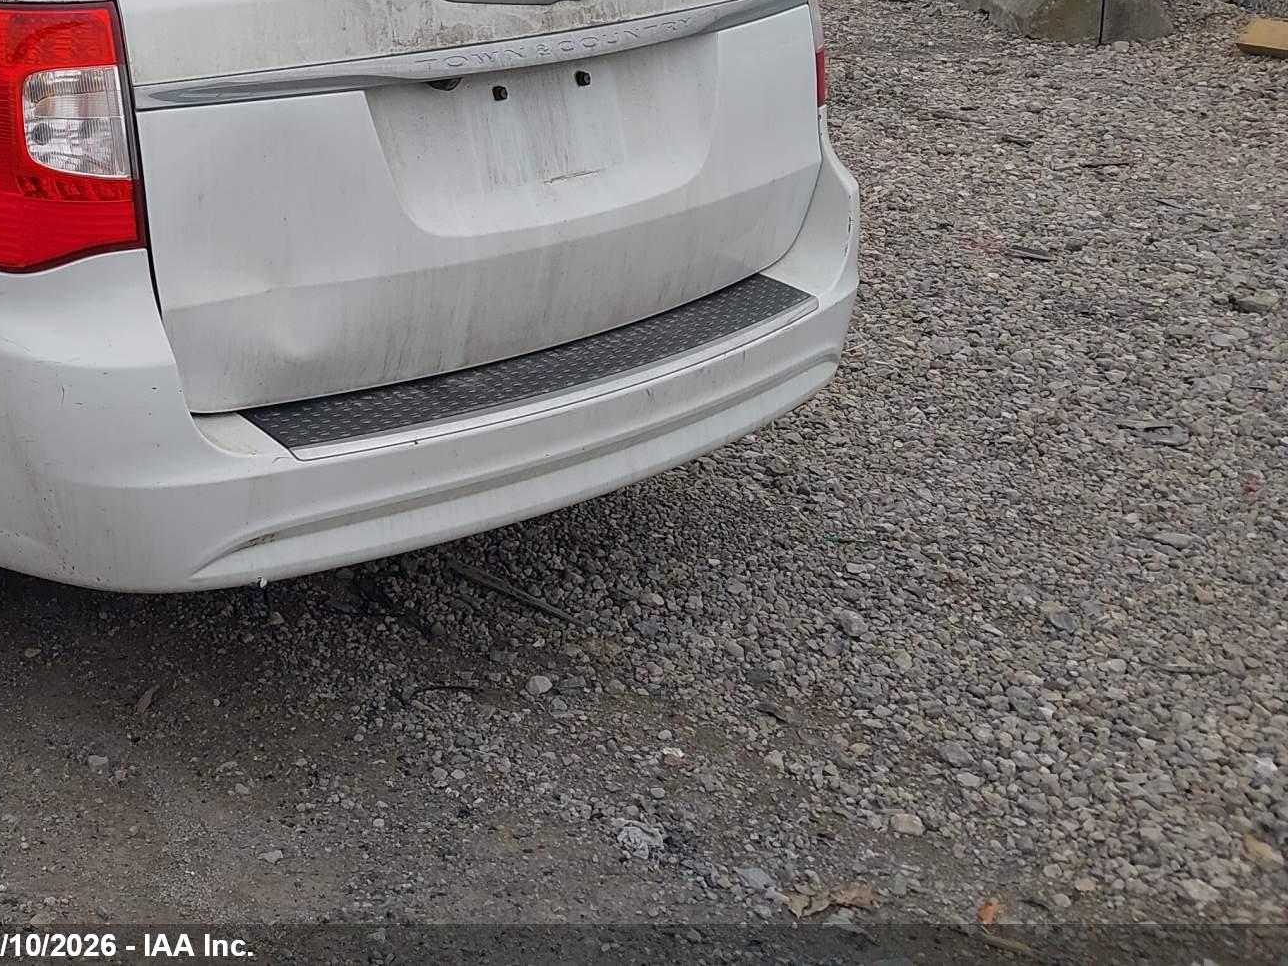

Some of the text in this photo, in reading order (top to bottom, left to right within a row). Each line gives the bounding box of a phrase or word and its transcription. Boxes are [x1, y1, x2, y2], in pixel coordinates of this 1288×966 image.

[415, 16, 693, 71] TOWN & COUNTRY
